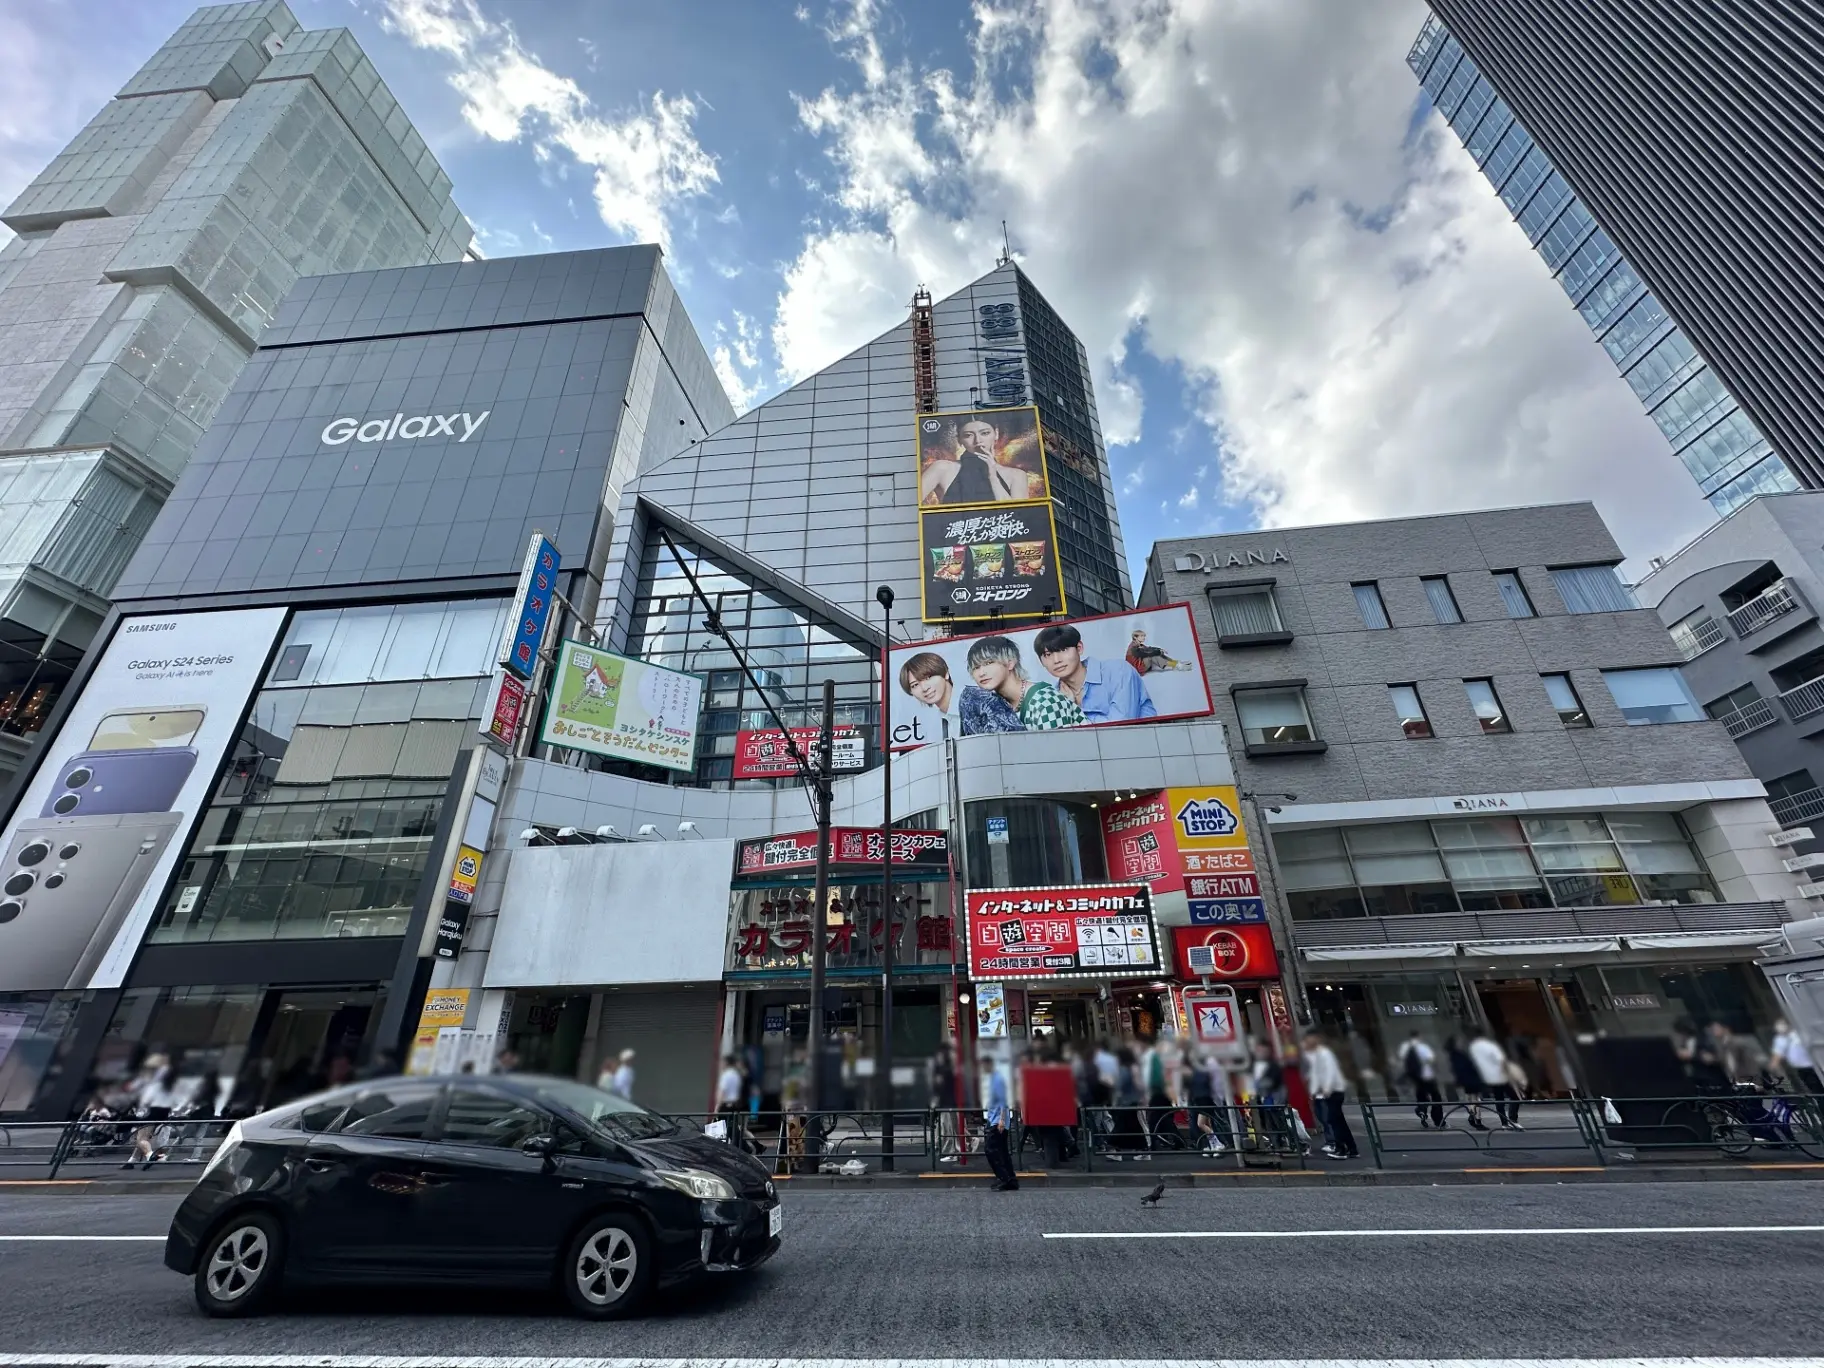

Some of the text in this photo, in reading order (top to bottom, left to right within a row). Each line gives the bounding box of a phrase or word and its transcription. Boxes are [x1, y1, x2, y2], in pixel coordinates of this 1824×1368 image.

[321, 410, 490, 446] Galaxy
[1175, 547, 1289, 574] DIANA
[972, 588, 1032, 602] ストロング
[517, 551, 553, 664] カラオケ館
[126, 622, 177, 634] SAMSUNG
[127, 654, 234, 670] Galaxy S24 Series
[135, 672, 165, 681] Galaxy
[620, 723, 690, 746] ヨシタケシンスケ
[889, 715, 925, 745] et
[552, 720, 689, 758] おしごとそうだんセンター
[1453, 798, 1509, 811] DIANA
[1191, 808, 1223, 820] MINI
[1107, 812, 1167, 834] コミックカフェ
[1191, 820, 1226, 832] STOP
[1124, 850, 1161, 876] 空間
[1185, 853, 1248, 870] 酒・たばこ
[1190, 877, 1254, 896] 銀行ATM
[977, 896, 1145, 915] インターネット&コミックカフェ
[1195, 902, 1242, 920] この奥
[440, 918, 460, 931] Galaxy
[979, 919, 1071, 946] 自遊空間
[437, 929, 463, 940] Harajuku
[738, 914, 951, 958] カラオケ館
[1212, 942, 1237, 950] KEBAB
[980, 957, 1041, 969] 24時間営業
[425, 1003, 465, 1011] EXCHANGE
[1393, 1003, 1435, 1014] DIANA
[1614, 996, 1653, 1008] DIANA
